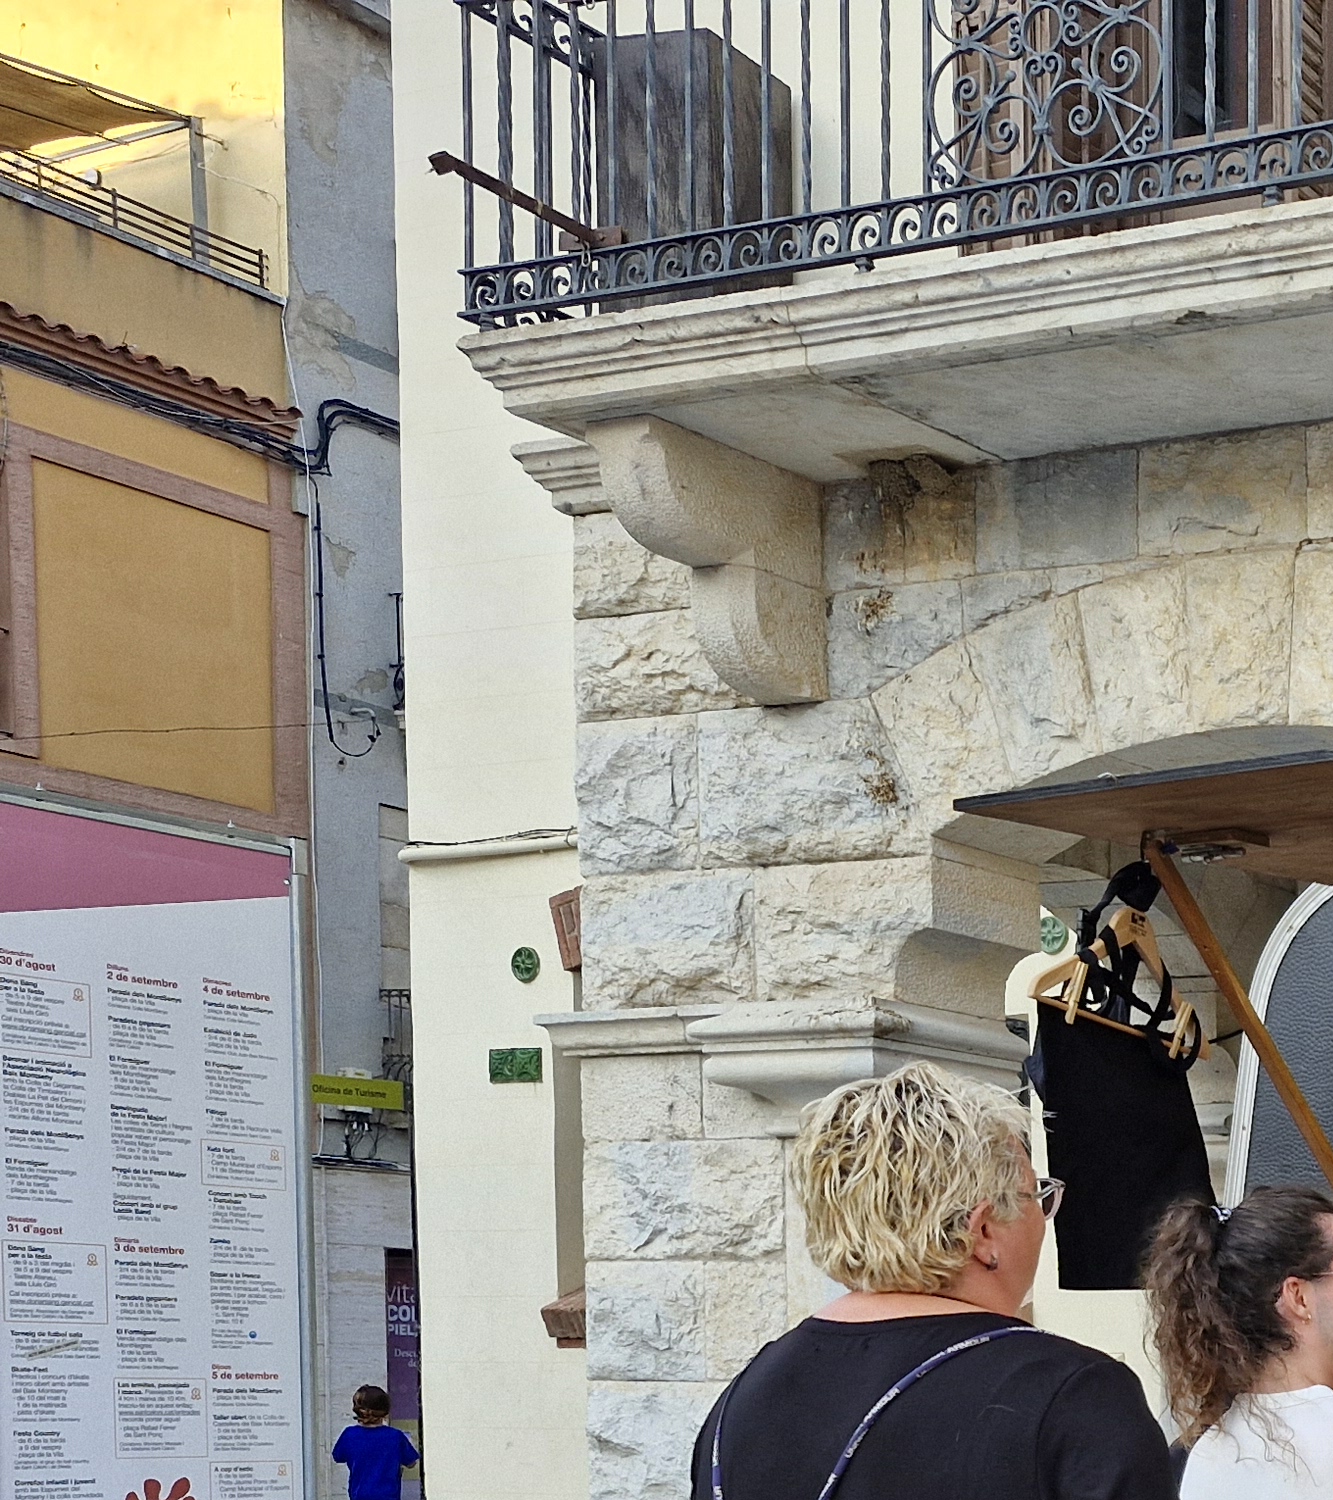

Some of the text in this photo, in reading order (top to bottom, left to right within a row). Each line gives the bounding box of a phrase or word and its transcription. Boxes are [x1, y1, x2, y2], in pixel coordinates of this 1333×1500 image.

[15, 957, 56, 971] d'agost
[107, 971, 178, 989] 2 de setembre
[202, 985, 271, 1002] 4 de setembre
[312, 1084, 341, 1095] Oficina
[355, 1088, 387, 1098] Turisme
[7, 1224, 63, 1236] 31 d'agost
[114, 1244, 185, 1255] 3 de setembre
[211, 1371, 280, 1380] 5 de setembre
